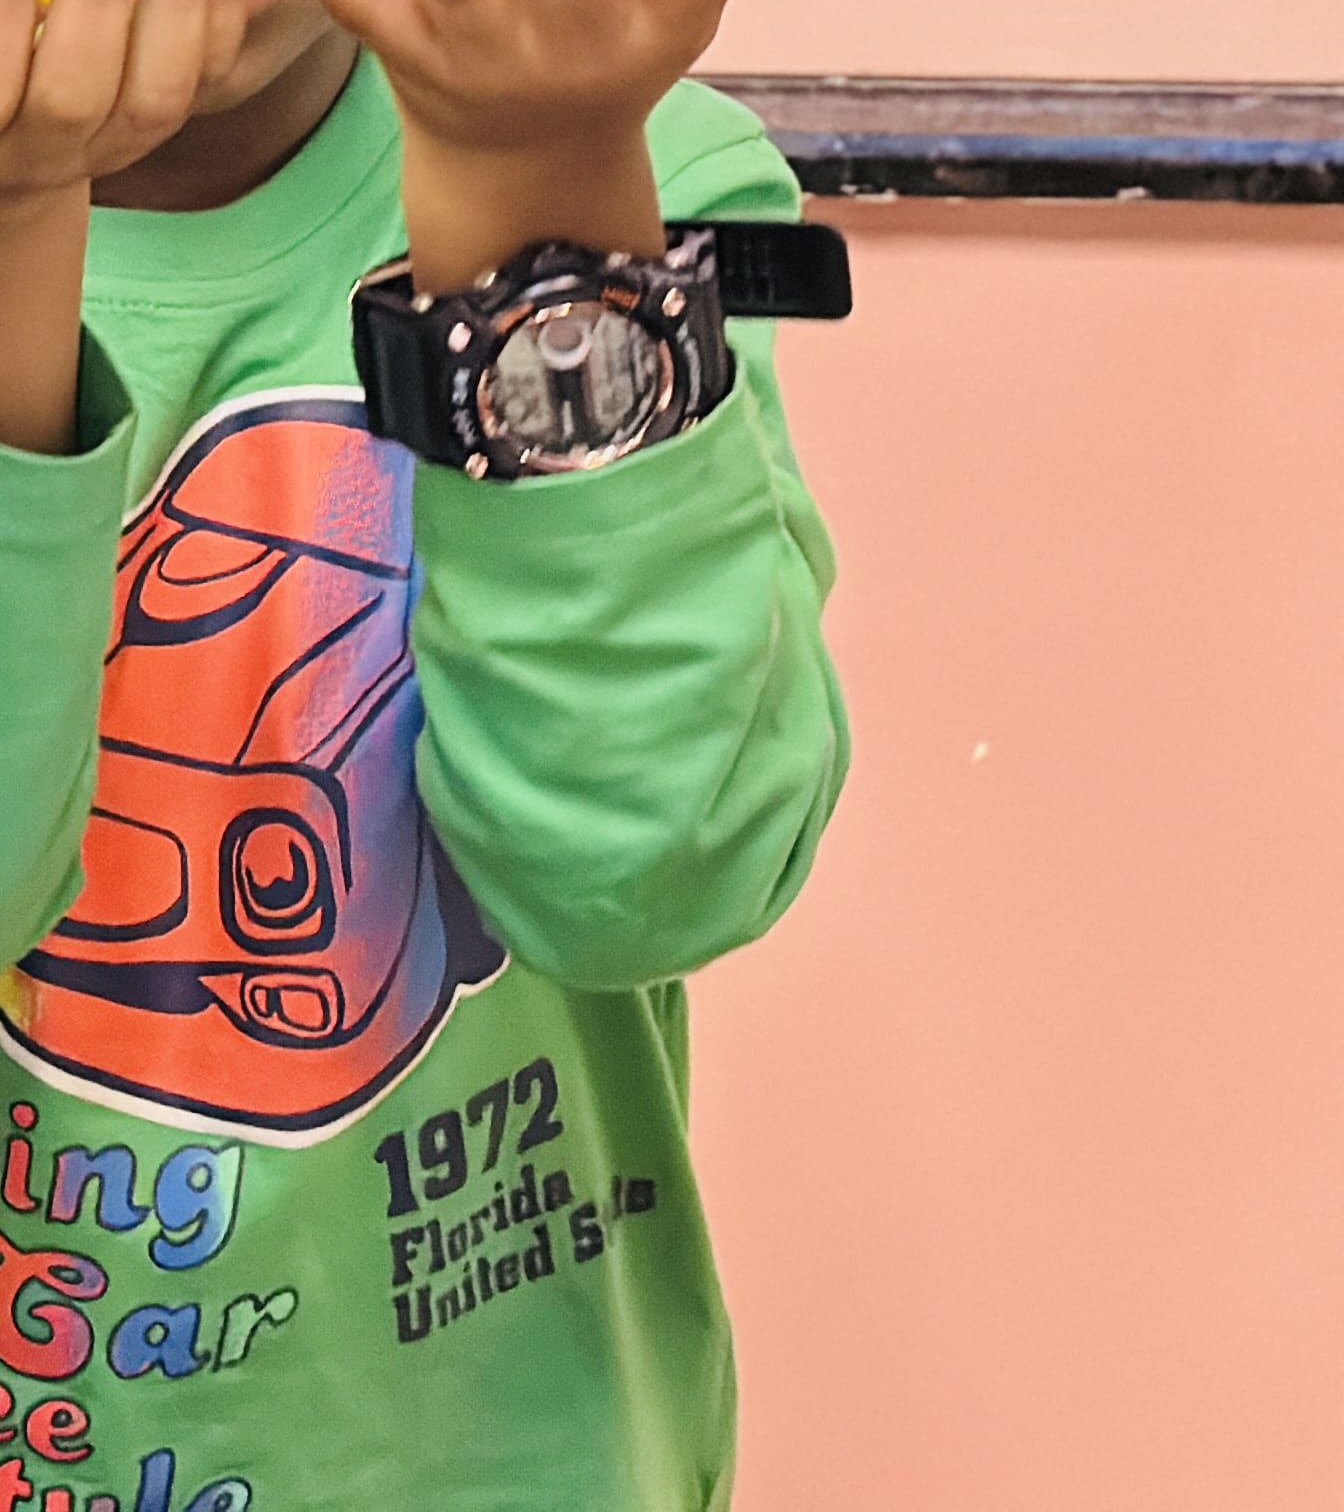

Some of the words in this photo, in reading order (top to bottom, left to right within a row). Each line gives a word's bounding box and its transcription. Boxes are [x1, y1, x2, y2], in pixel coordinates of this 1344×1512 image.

[374, 1056, 564, 1218] 1972
[389, 1163, 576, 1288] Florida
[391, 1223, 556, 1345] United
